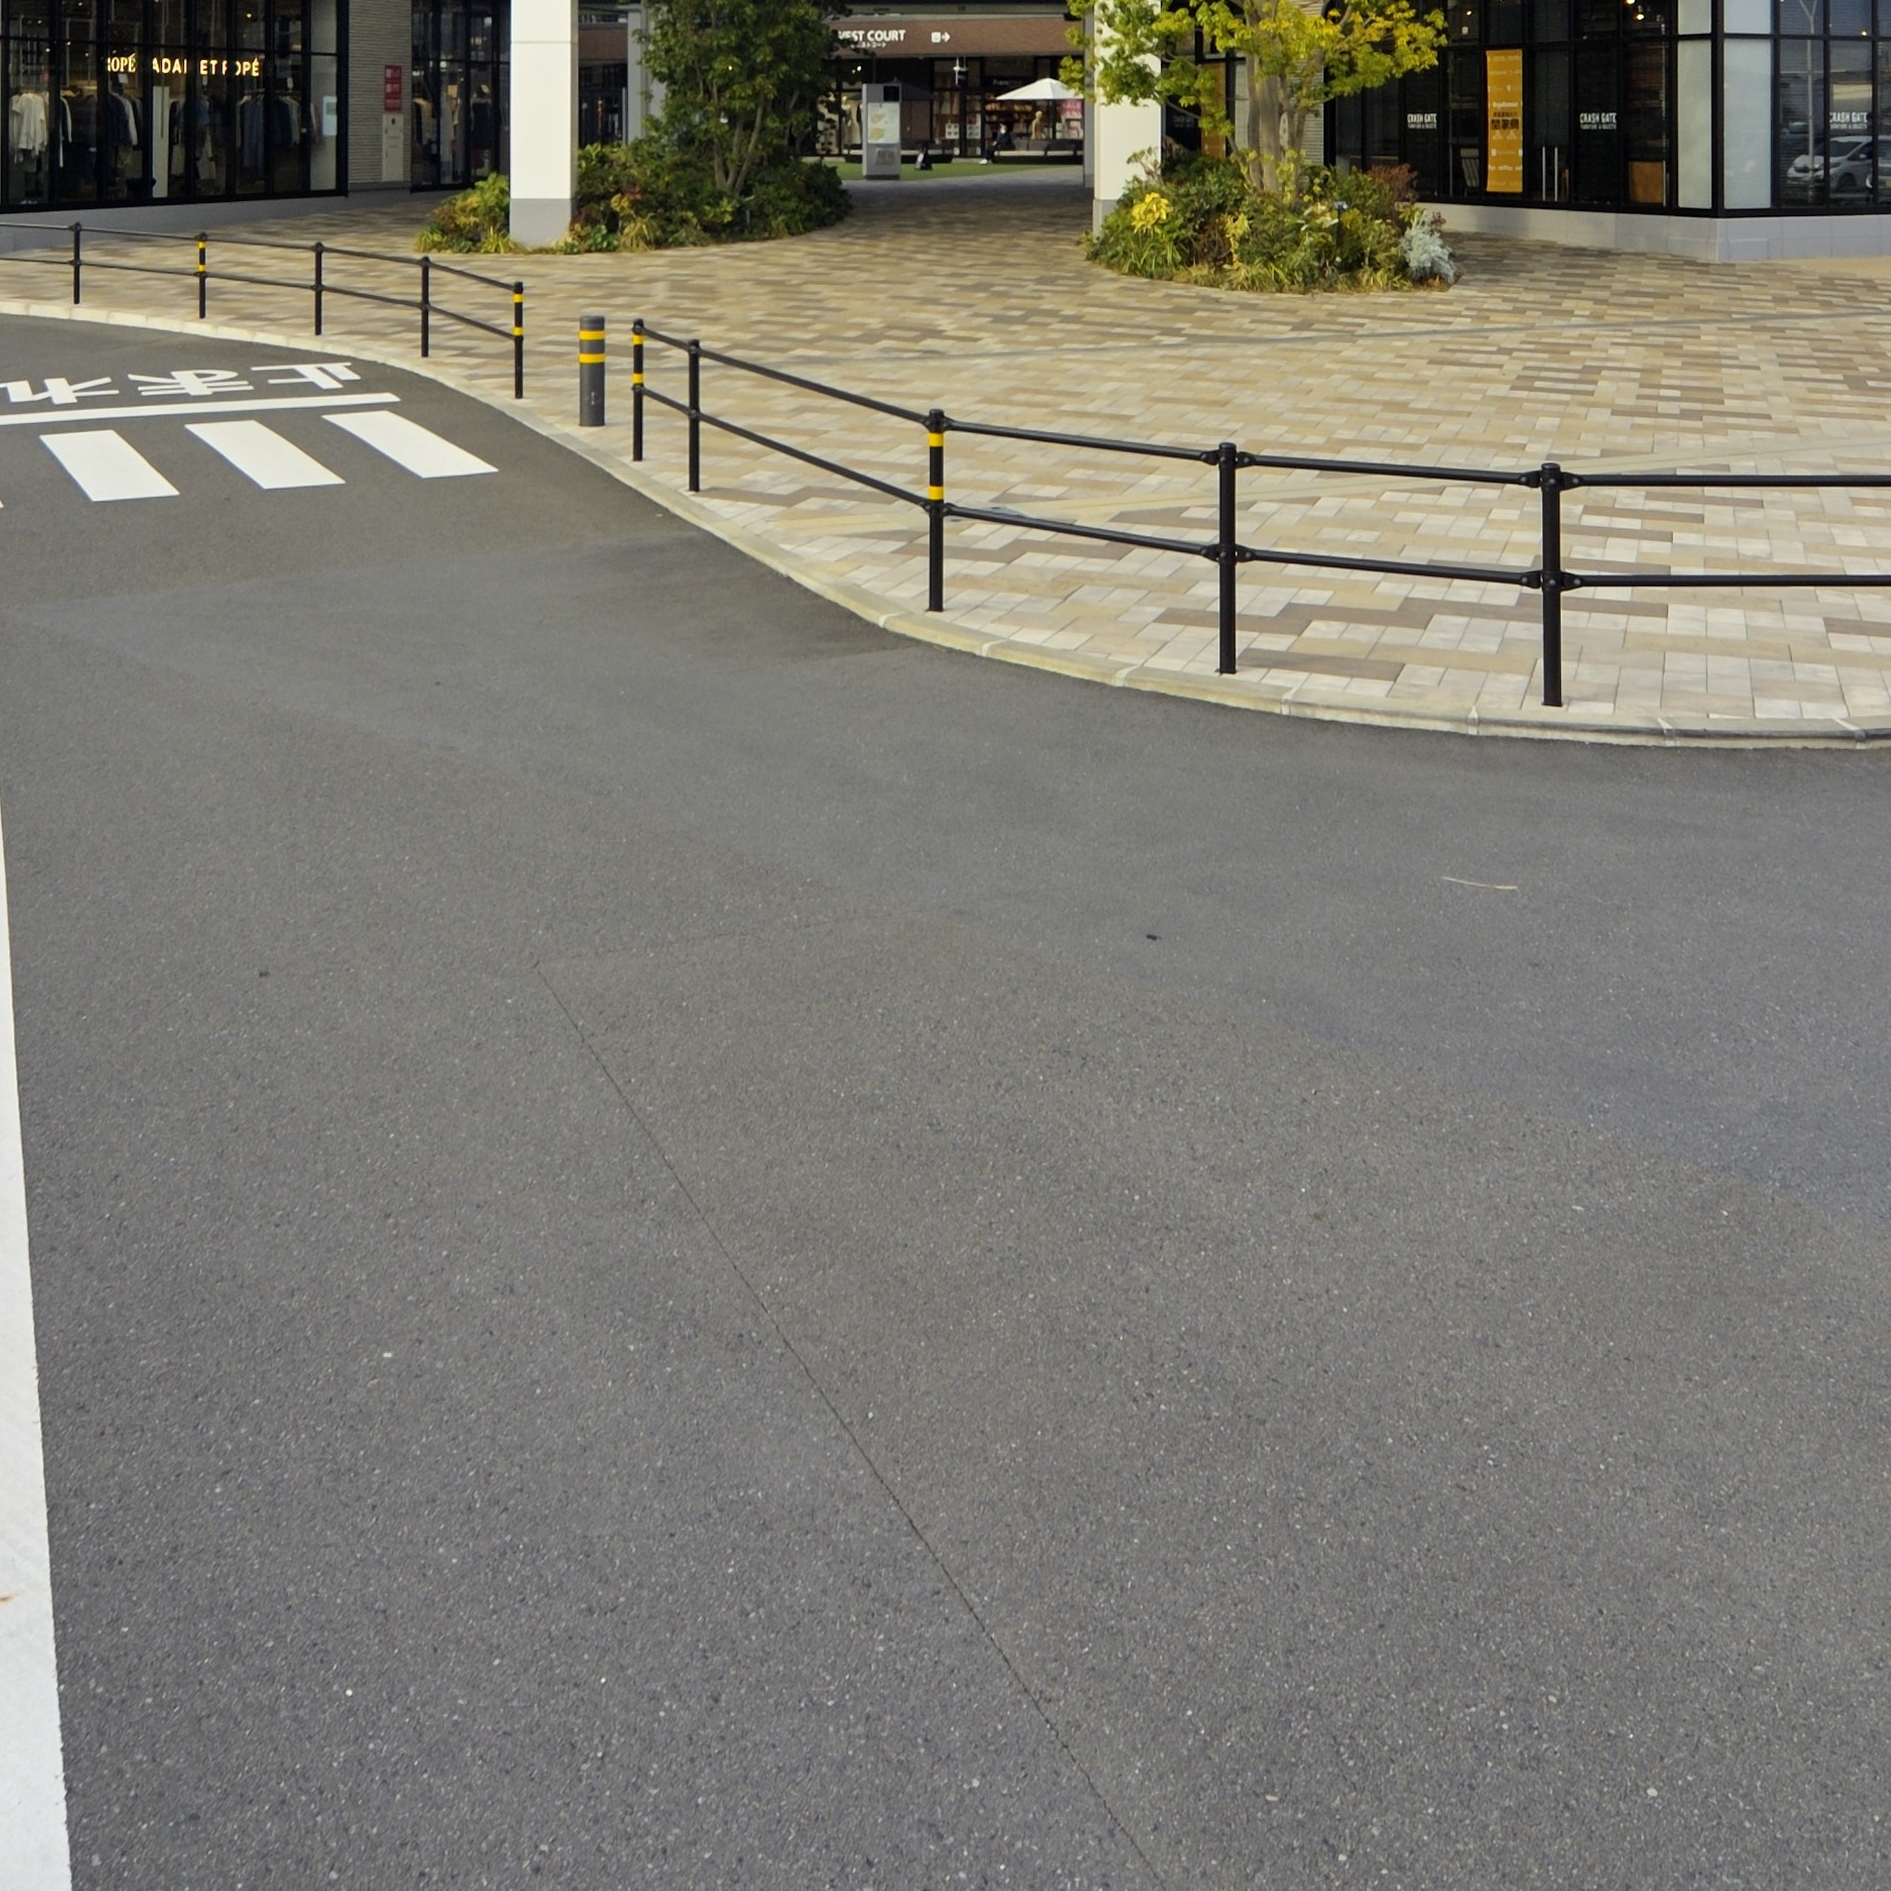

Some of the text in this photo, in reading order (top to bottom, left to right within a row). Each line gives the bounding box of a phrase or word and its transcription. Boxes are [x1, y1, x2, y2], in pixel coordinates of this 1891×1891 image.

[867, 30, 907, 42] COURT
[1579, 112, 1617, 123] CRASH GATE
